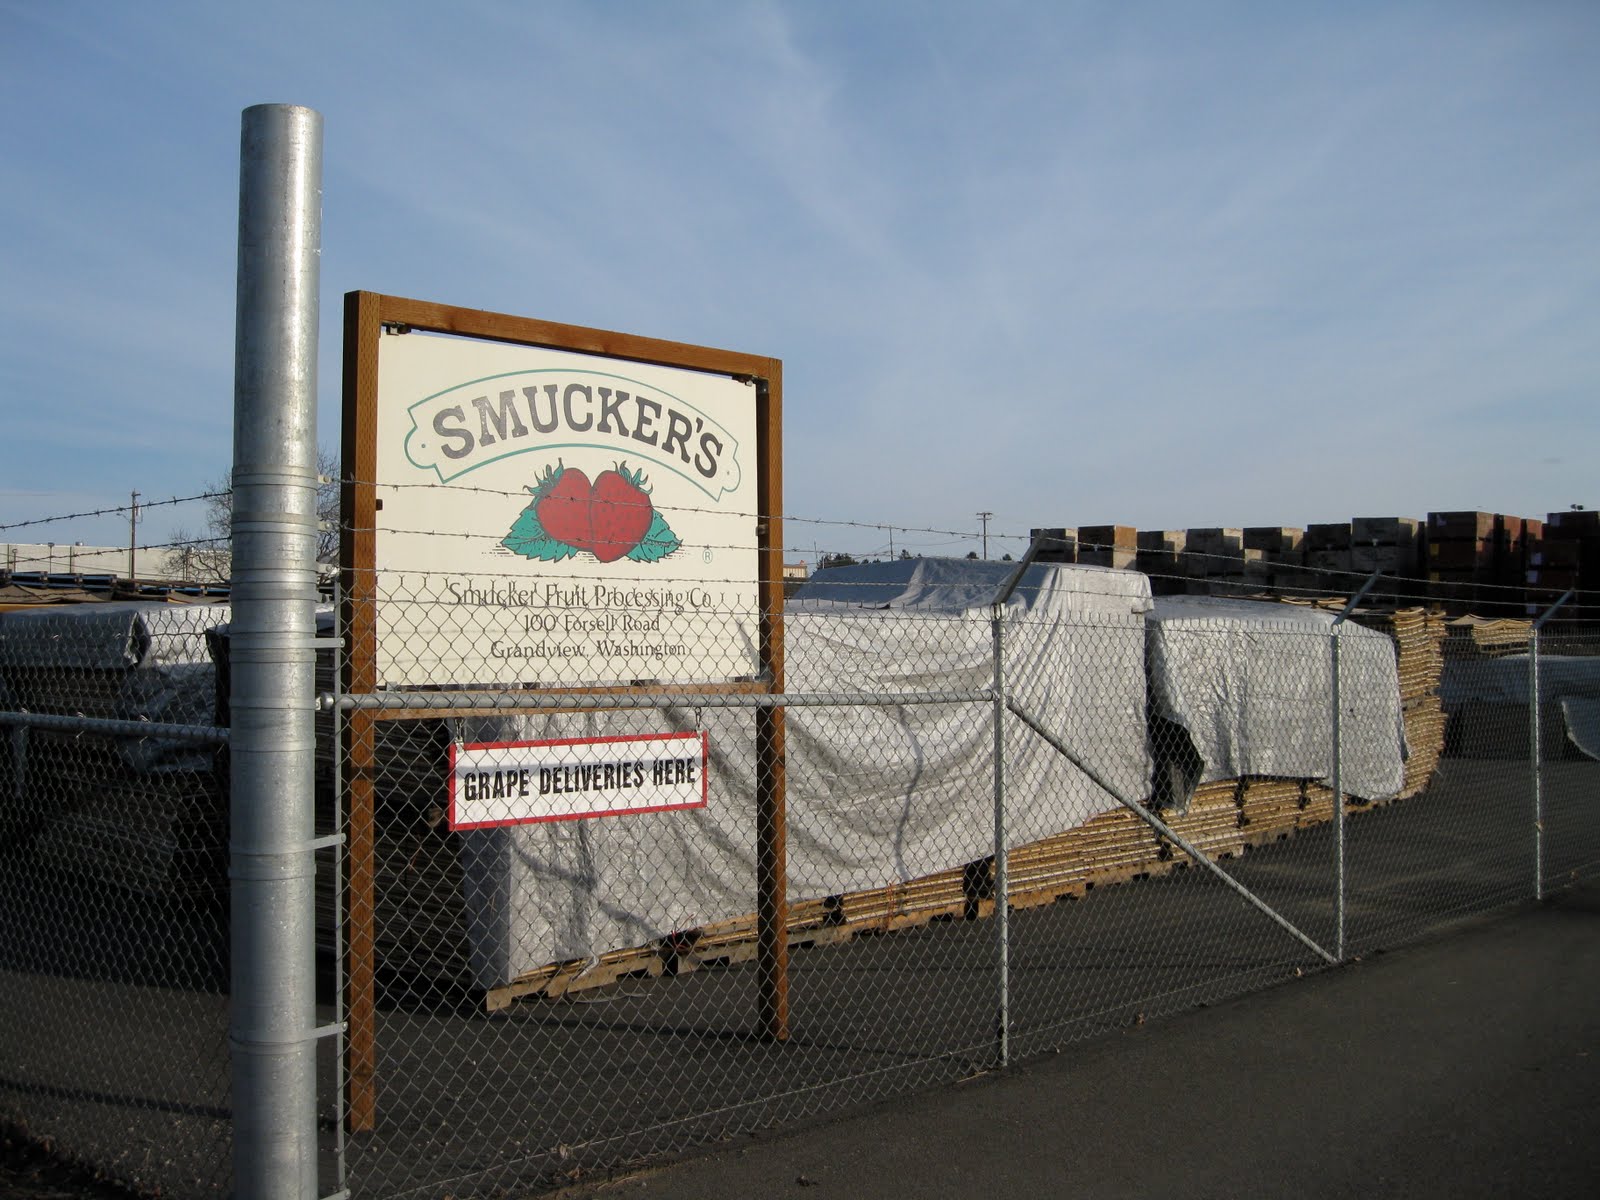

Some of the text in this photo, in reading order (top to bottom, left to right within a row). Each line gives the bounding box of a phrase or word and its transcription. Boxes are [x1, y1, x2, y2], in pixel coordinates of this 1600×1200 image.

[432, 383, 724, 479] SMUCKER'S
[449, 582, 716, 615] Smucker Fruit Processing Co.
[524, 614, 661, 632] 100 Forsell Road
[596, 639, 686, 661] Washington
[464, 758, 696, 801] GRAPE DELIVERIES HERE
